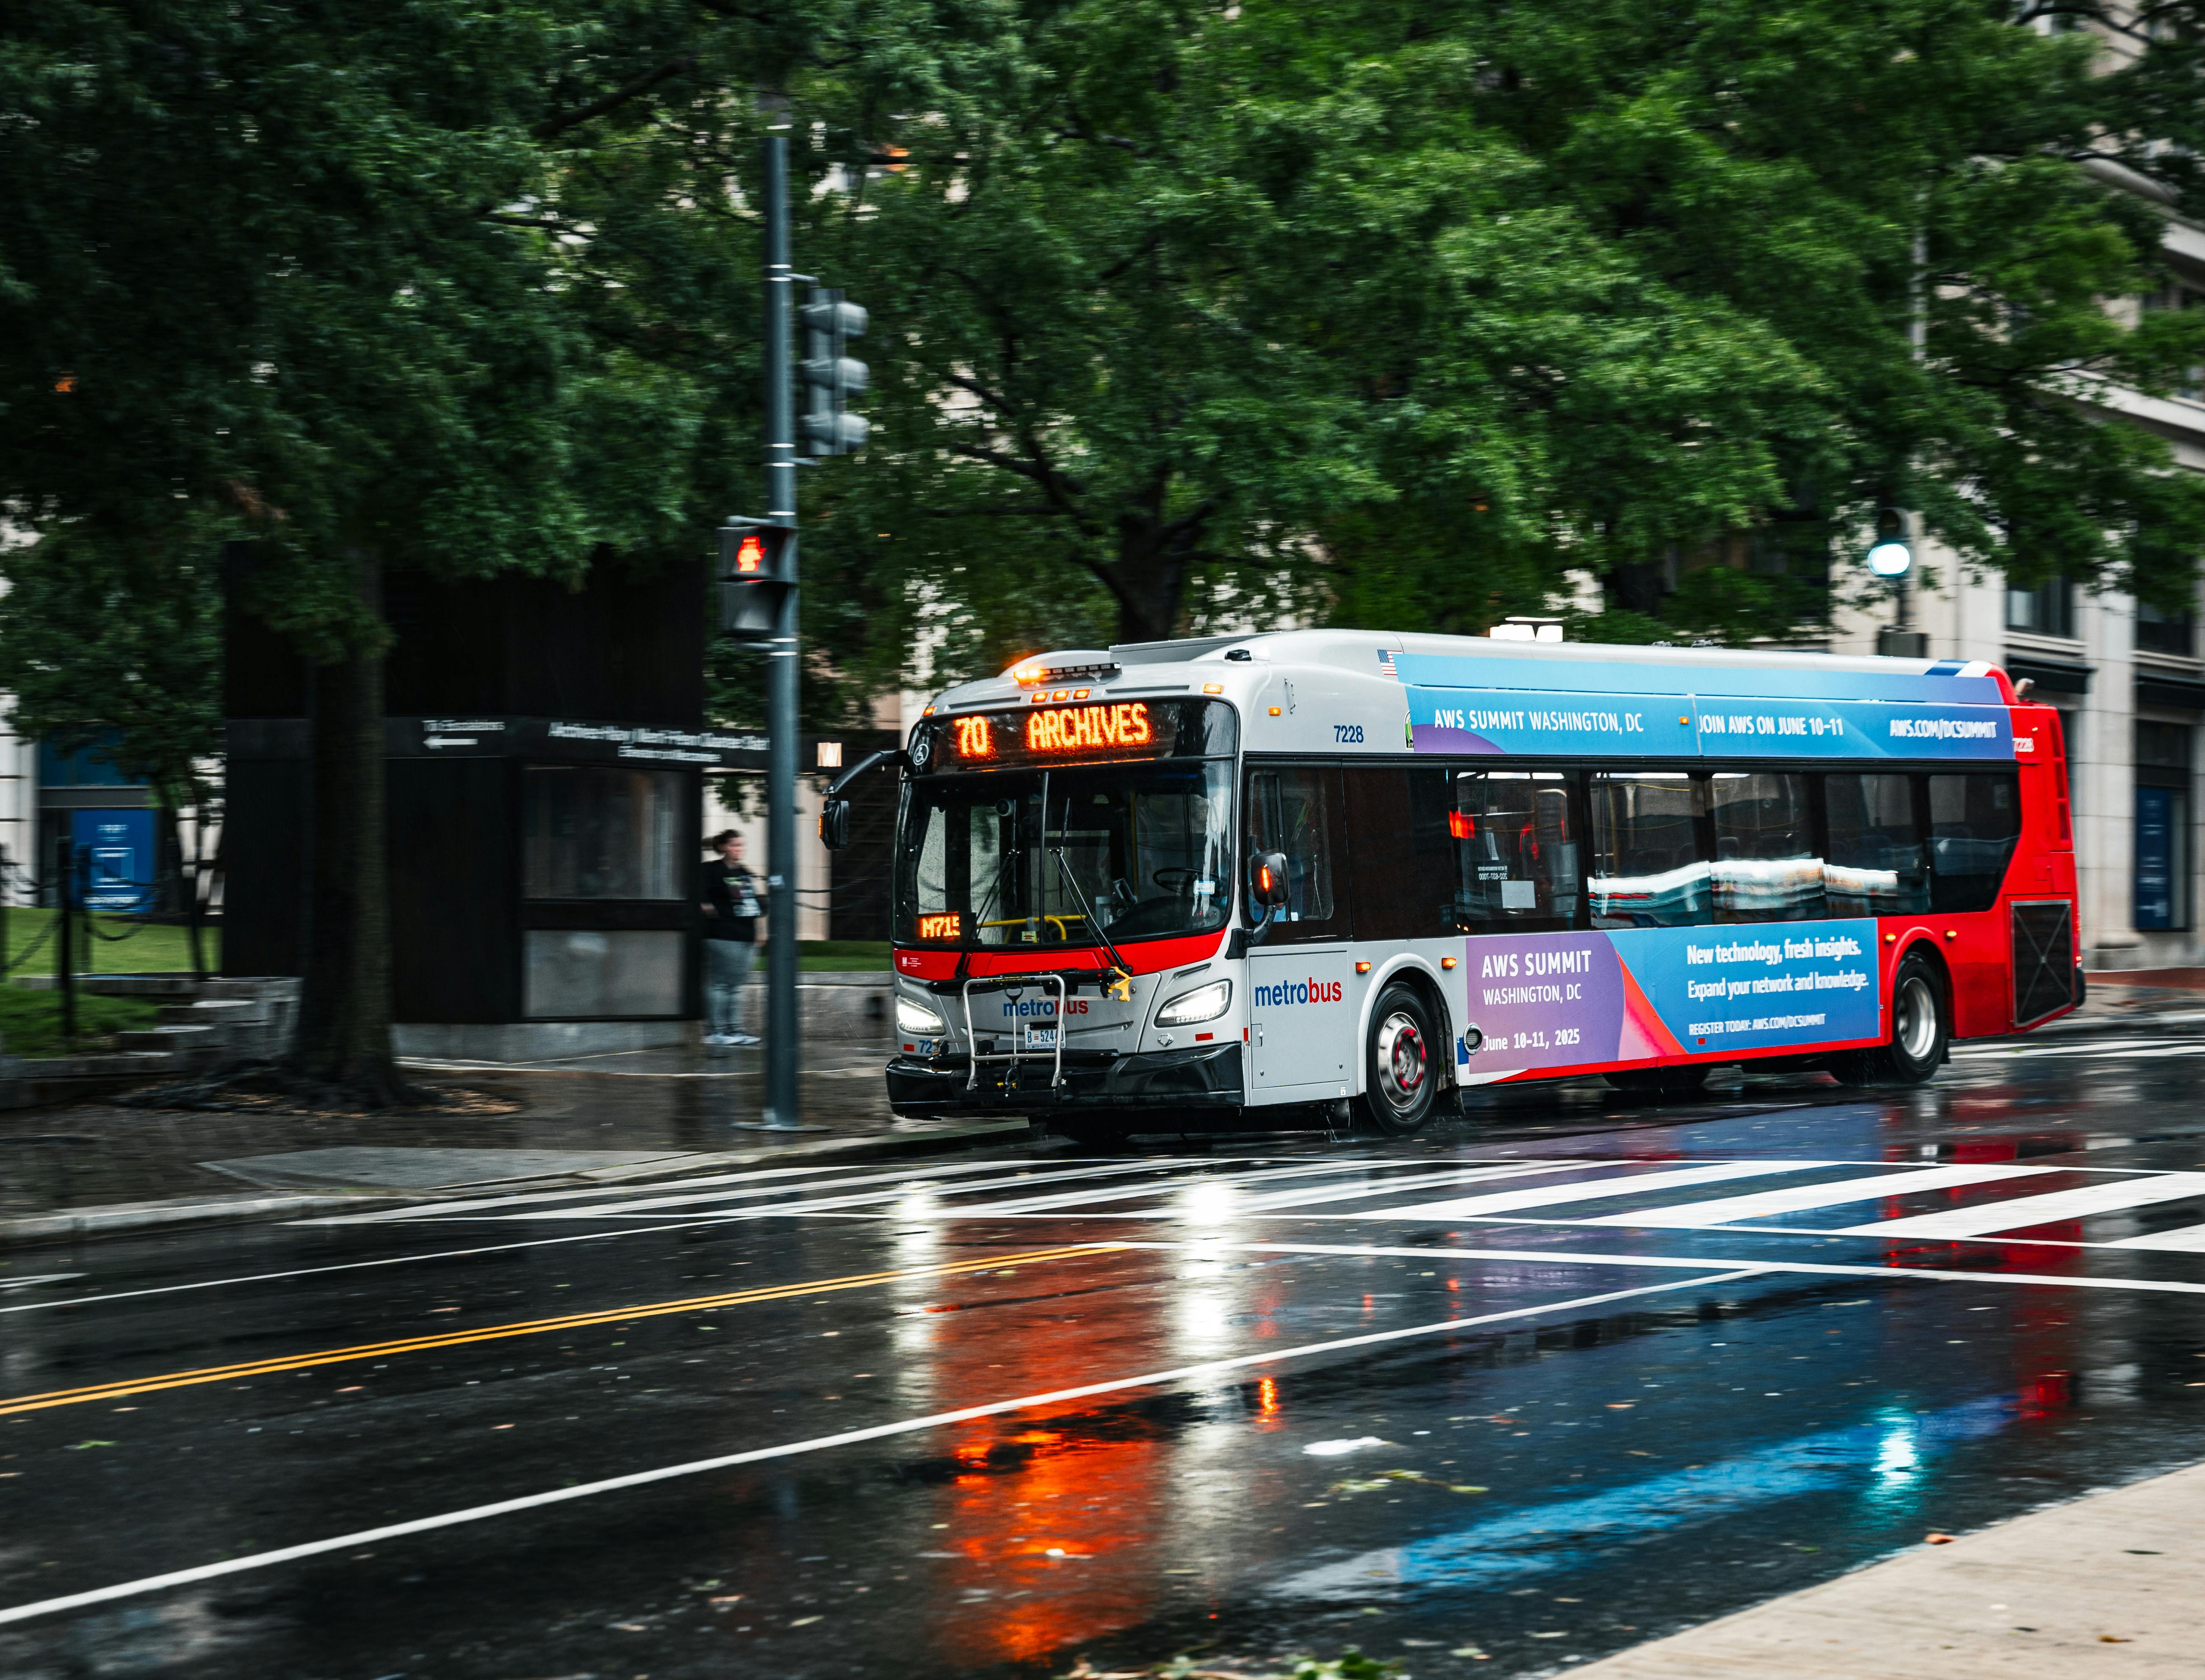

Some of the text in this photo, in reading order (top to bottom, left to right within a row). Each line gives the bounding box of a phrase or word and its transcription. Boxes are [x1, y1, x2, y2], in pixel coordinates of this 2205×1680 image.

[955, 703, 1148, 754] 70 ARCHIVES
[1334, 725, 1364, 743] 7228
[1434, 709, 1644, 735] AWS SUMMIT WASHINGTON, DC
[1699, 715, 1726, 733] JOIN
[1729, 715, 1755, 734] AWS
[1757, 716, 1776, 735] ON
[1778, 717, 1807, 735] JUNE
[1890, 719, 1997, 740] AWS.COM/DCSUMMIT
[1687, 936, 1862, 965] New technology, fresh insights.
[1482, 950, 1592, 978] AWS SUMMIT
[1255, 977, 1342, 1007] metrobus
[1483, 983, 1582, 1005] WASHINGTON, DC
[1688, 969, 1869, 1002] Expand your network and knowledge.
[1689, 1013, 1826, 1035] REGISTER TODAY: AWS.COM/DCSUMMIT
[1027, 1031, 1032, 1043] B
[1483, 1035, 1508, 1052] June
[1555, 1028, 1580, 1046] 2025
